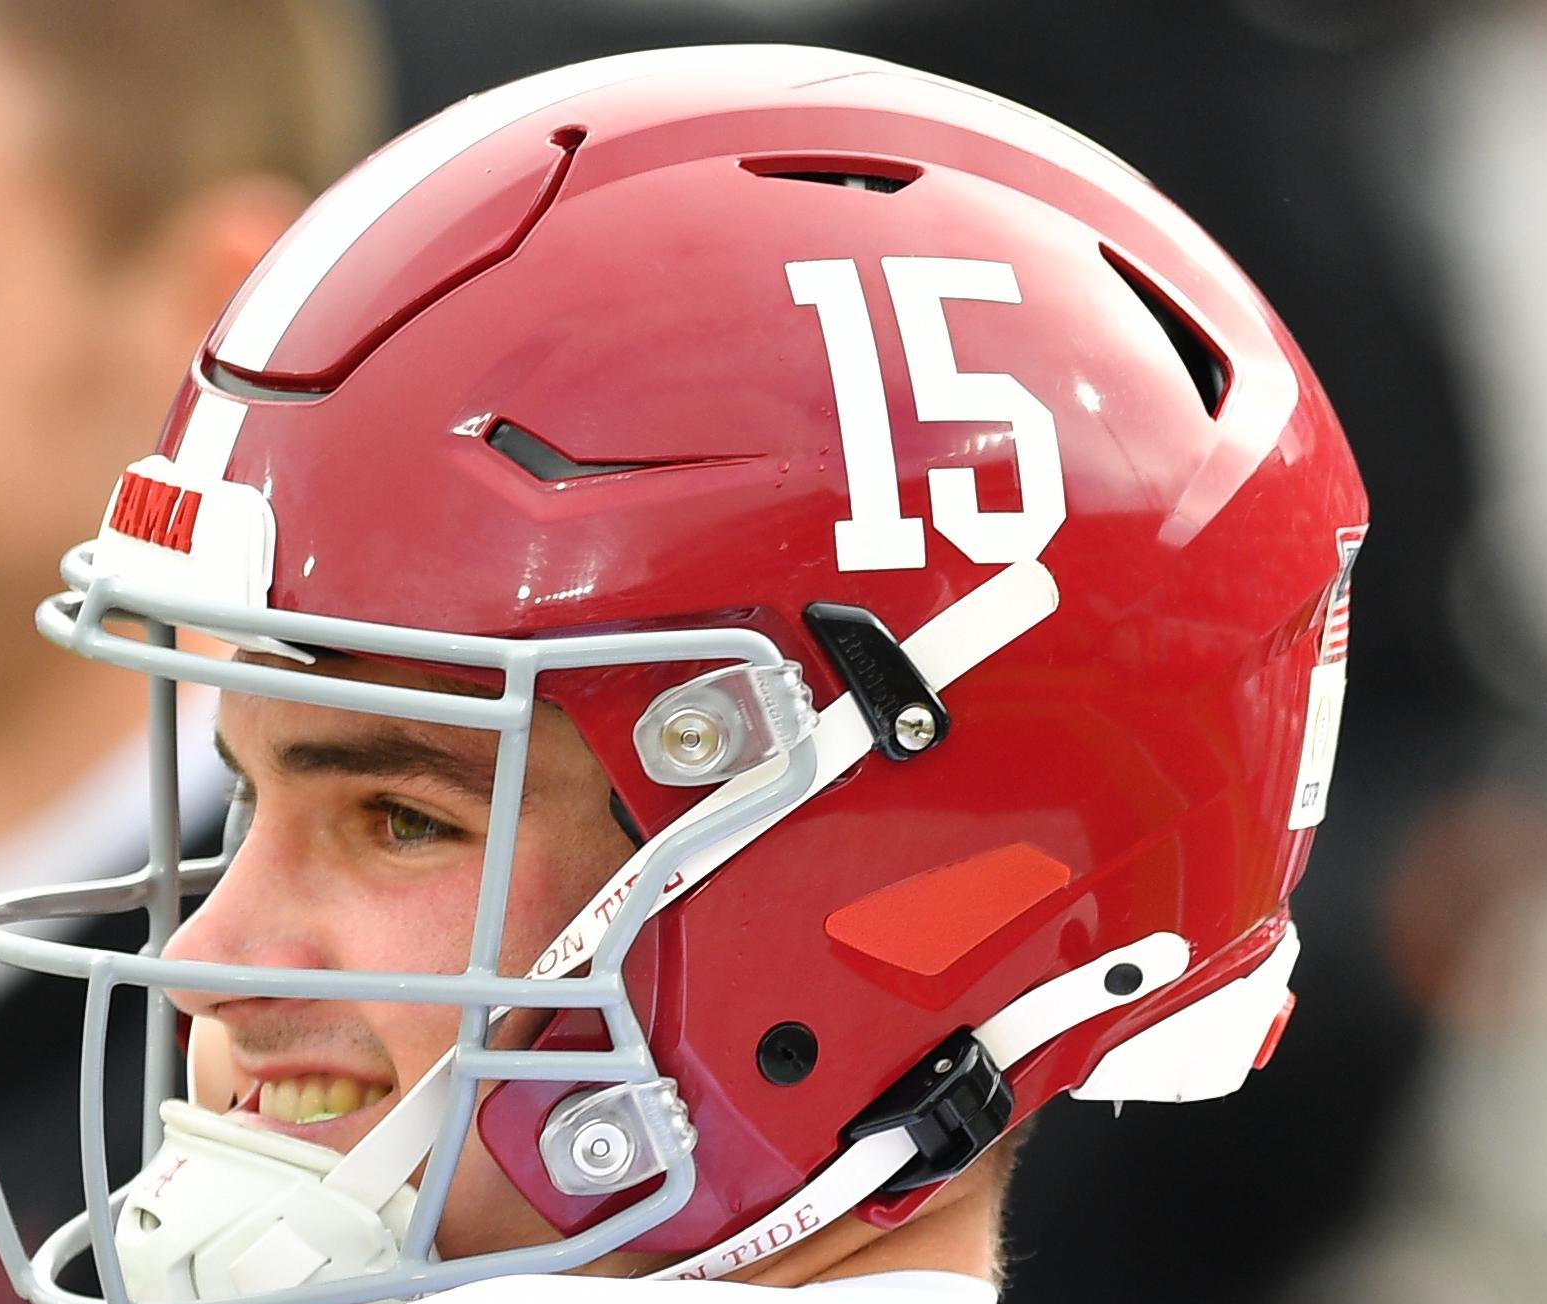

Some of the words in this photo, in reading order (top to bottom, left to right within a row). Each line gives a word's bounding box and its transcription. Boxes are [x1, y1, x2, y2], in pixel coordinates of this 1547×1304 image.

[784, 256, 1067, 572] 15
[527, 931, 584, 979] ON
[722, 1203, 821, 1267] TIDE
